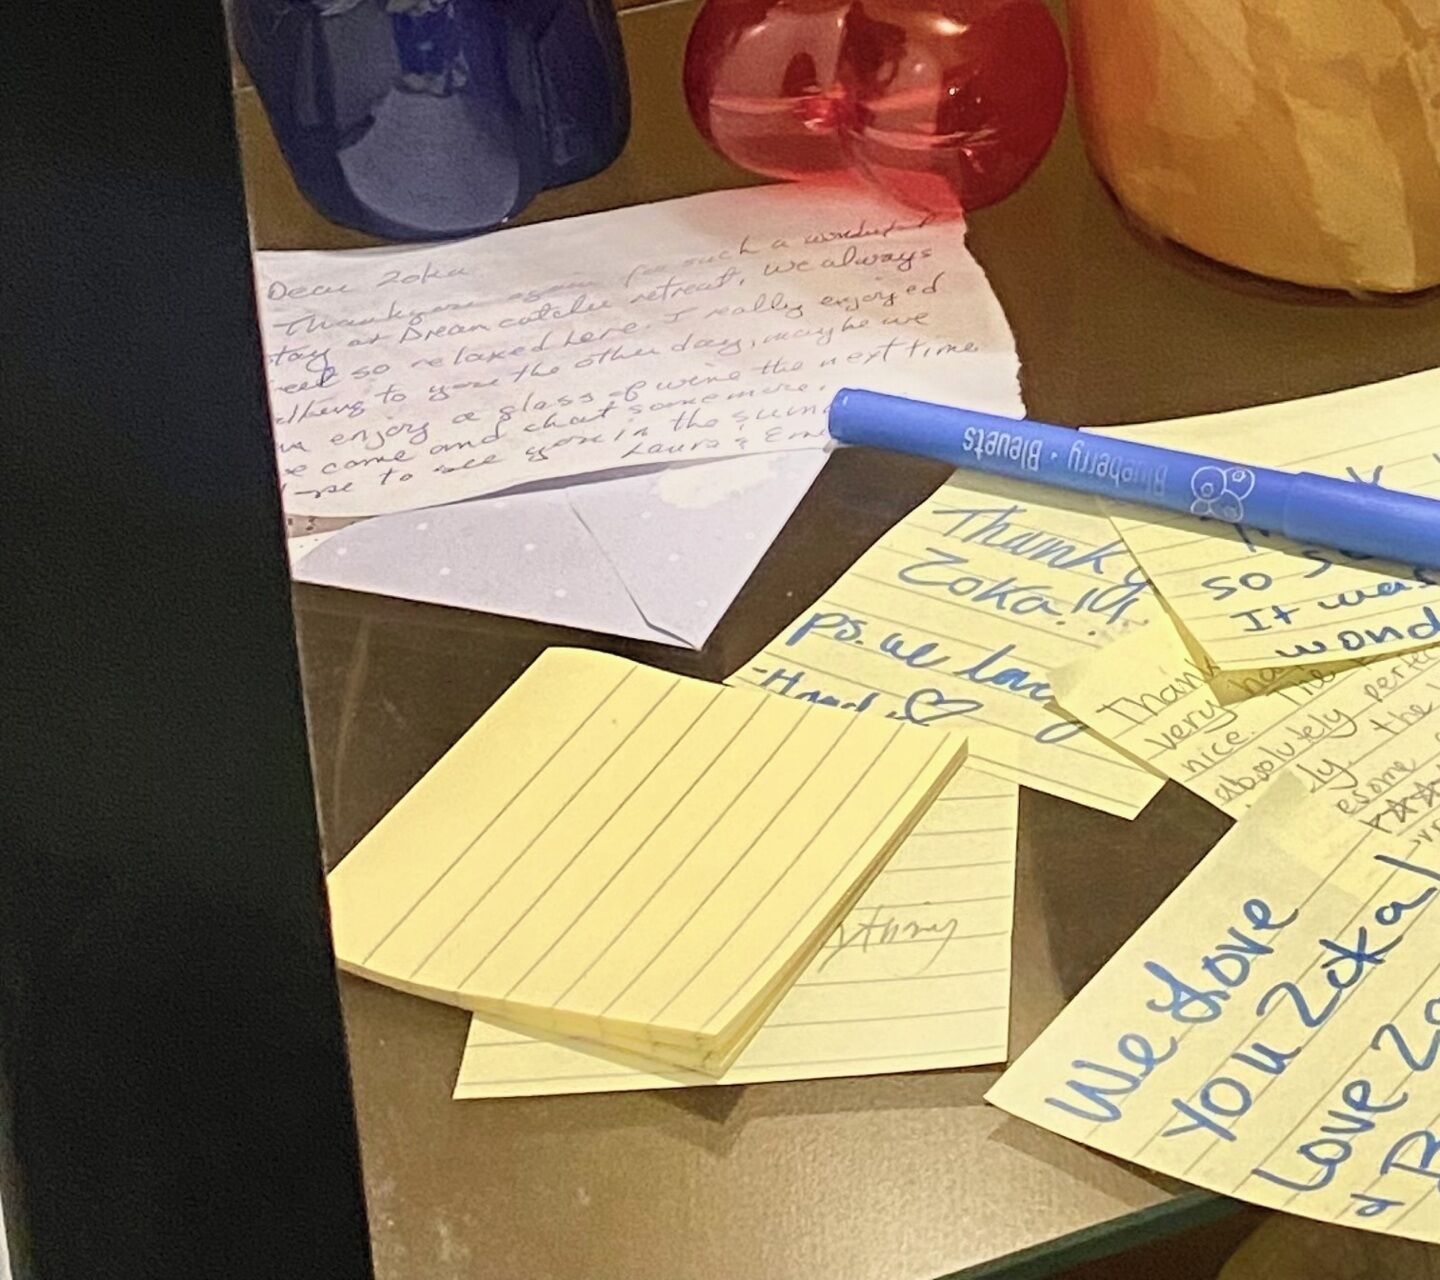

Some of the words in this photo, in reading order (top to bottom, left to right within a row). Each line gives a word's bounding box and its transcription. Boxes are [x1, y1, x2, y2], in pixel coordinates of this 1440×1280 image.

[771, 237, 790, 251] a
[351, 363, 391, 381] so
[374, 384, 407, 404] to
[509, 362, 561, 384] the
[451, 409, 484, 425] a
[497, 390, 597, 424] glass
[379, 468, 413, 486] to
[669, 408, 720, 433] the
[962, 425, 1044, 472] Bleuets
[1229, 606, 1301, 633] It
[1144, 698, 1239, 752] very
[1369, 700, 1434, 736] the
[1044, 1032, 1179, 1124] We
